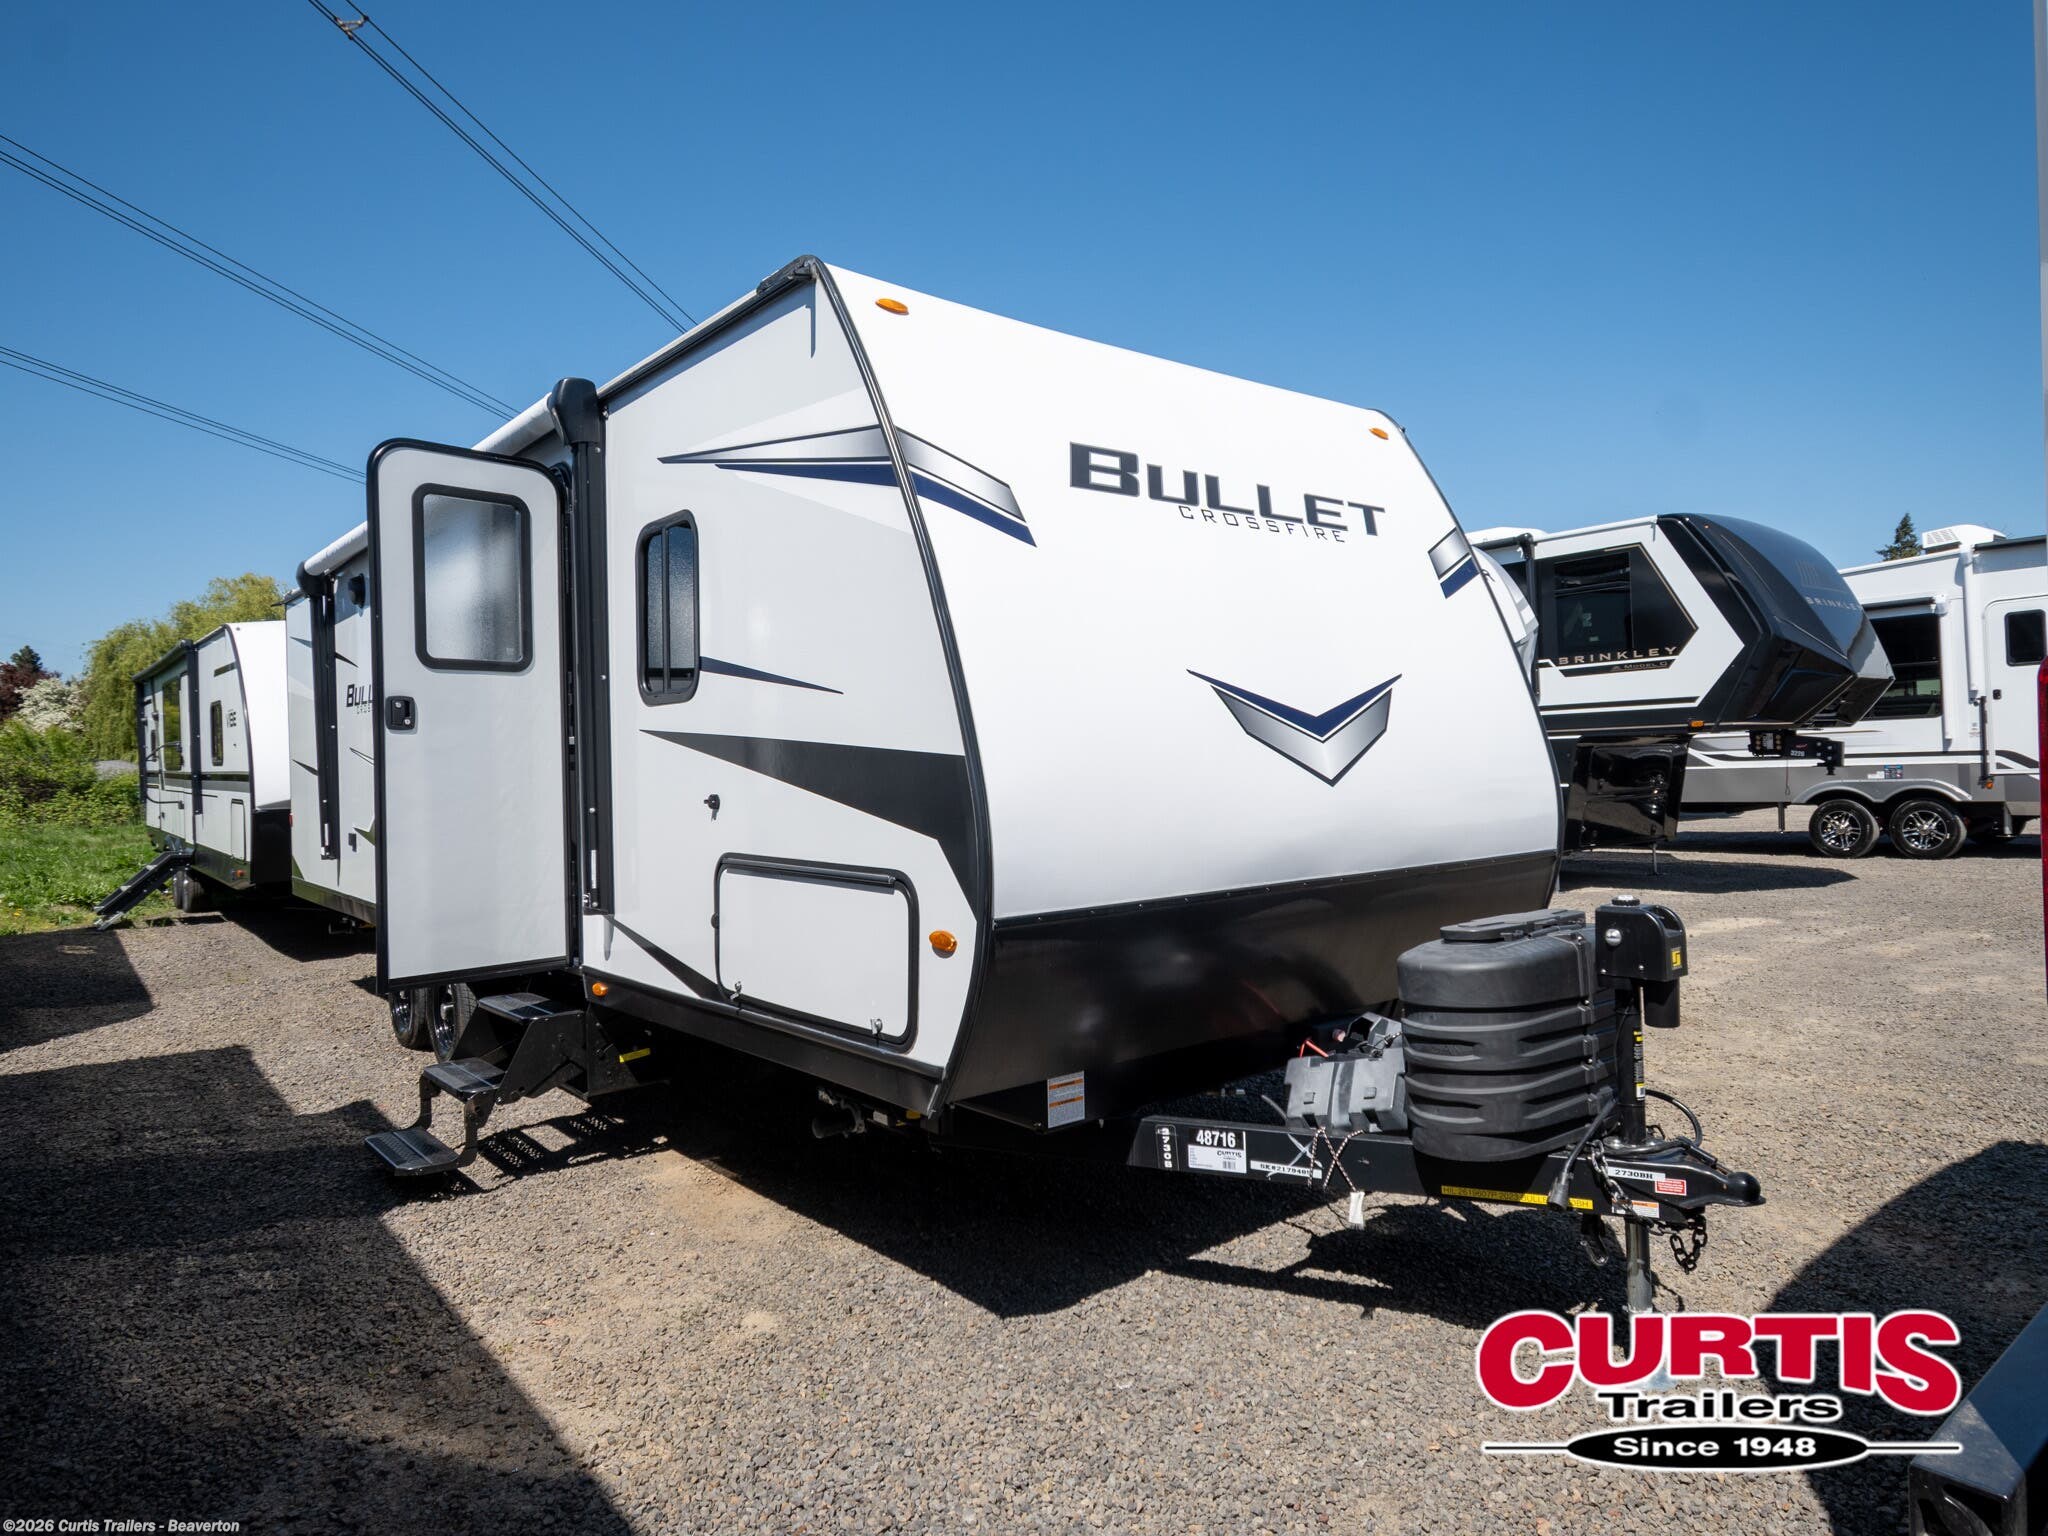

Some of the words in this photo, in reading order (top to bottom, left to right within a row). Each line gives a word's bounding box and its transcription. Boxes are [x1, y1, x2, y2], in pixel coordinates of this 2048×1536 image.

[1069, 441, 1386, 537] BULLET
[1178, 505, 1345, 543] CROSSFIRE
[1558, 646, 1677, 665] BRINKLEY
[346, 684, 374, 708] BULL
[1196, 1129, 1236, 1148] 48716
[1615, 1169, 1653, 1180] 2730BH
